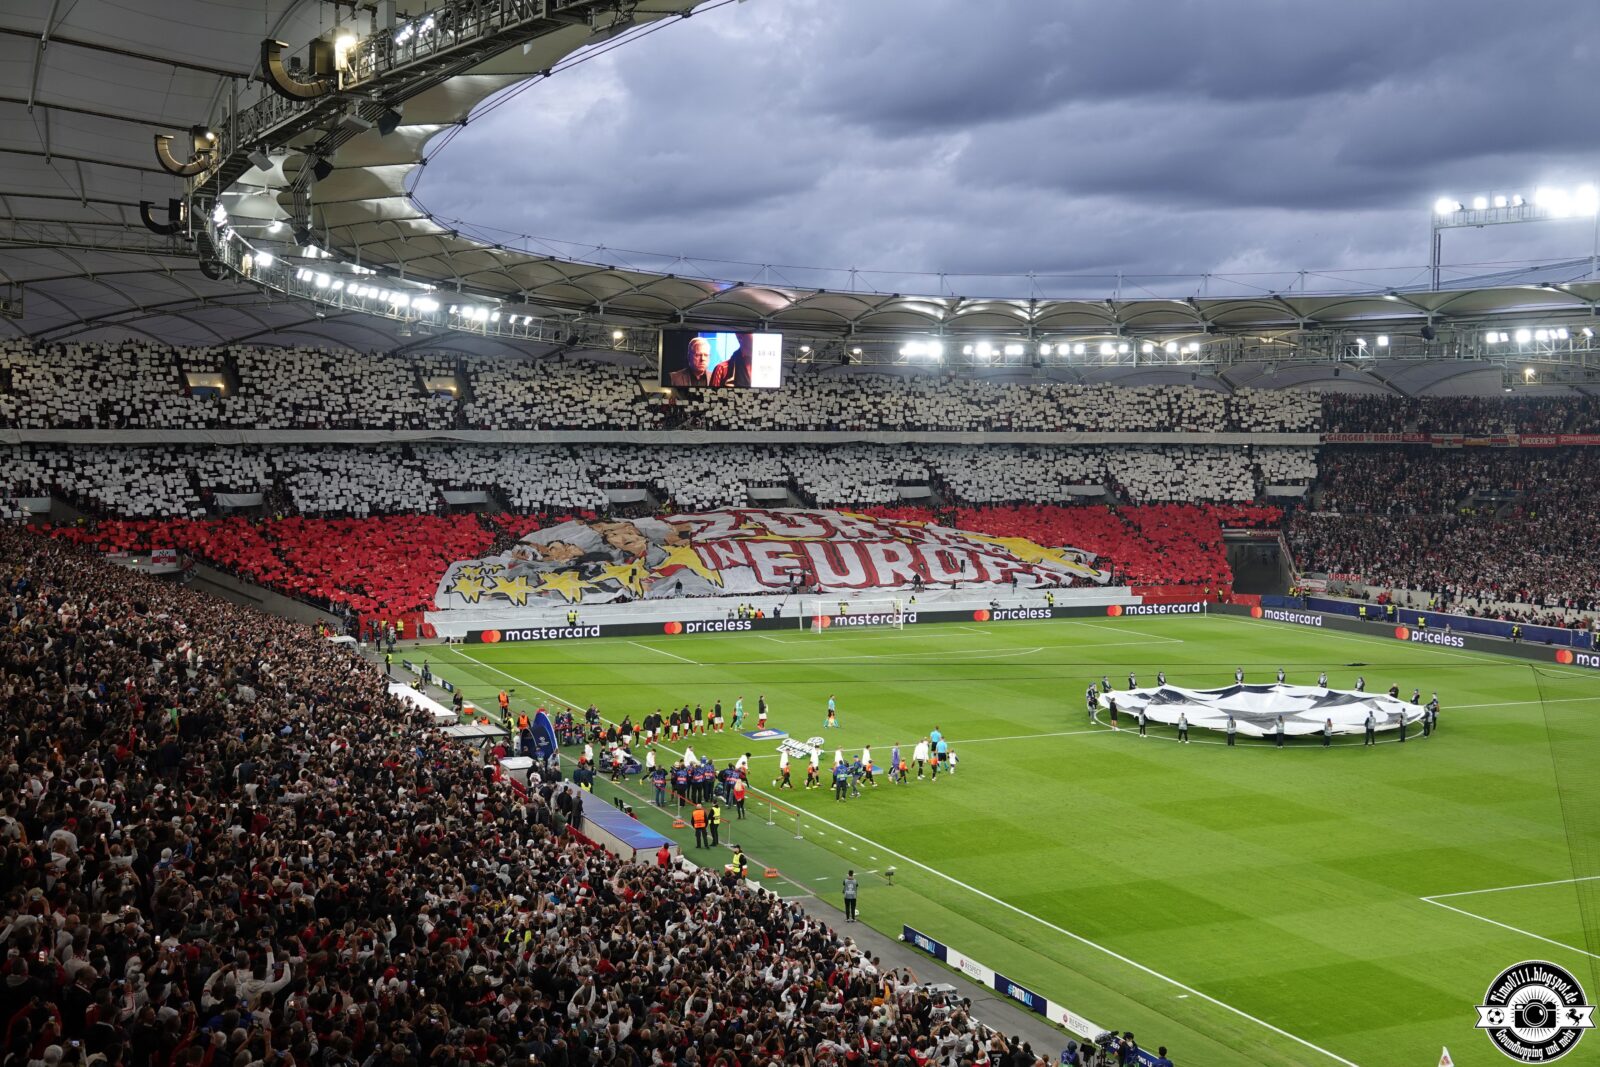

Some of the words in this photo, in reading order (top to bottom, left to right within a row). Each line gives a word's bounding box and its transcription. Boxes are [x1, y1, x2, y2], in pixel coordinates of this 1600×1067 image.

[1328, 573, 1362, 582] URBACH
[993, 608, 1052, 621] priceless
[1126, 602, 1200, 615] mastercard
[835, 612, 917, 625] mastercard
[1264, 609, 1322, 626] mastercard
[505, 624, 600, 641] mastercard
[686, 619, 752, 634] priceless
[1411, 629, 1464, 647] priceless
[964, 962, 982, 976] RESPECT
[1068, 1016, 1089, 1034] RESPECT
